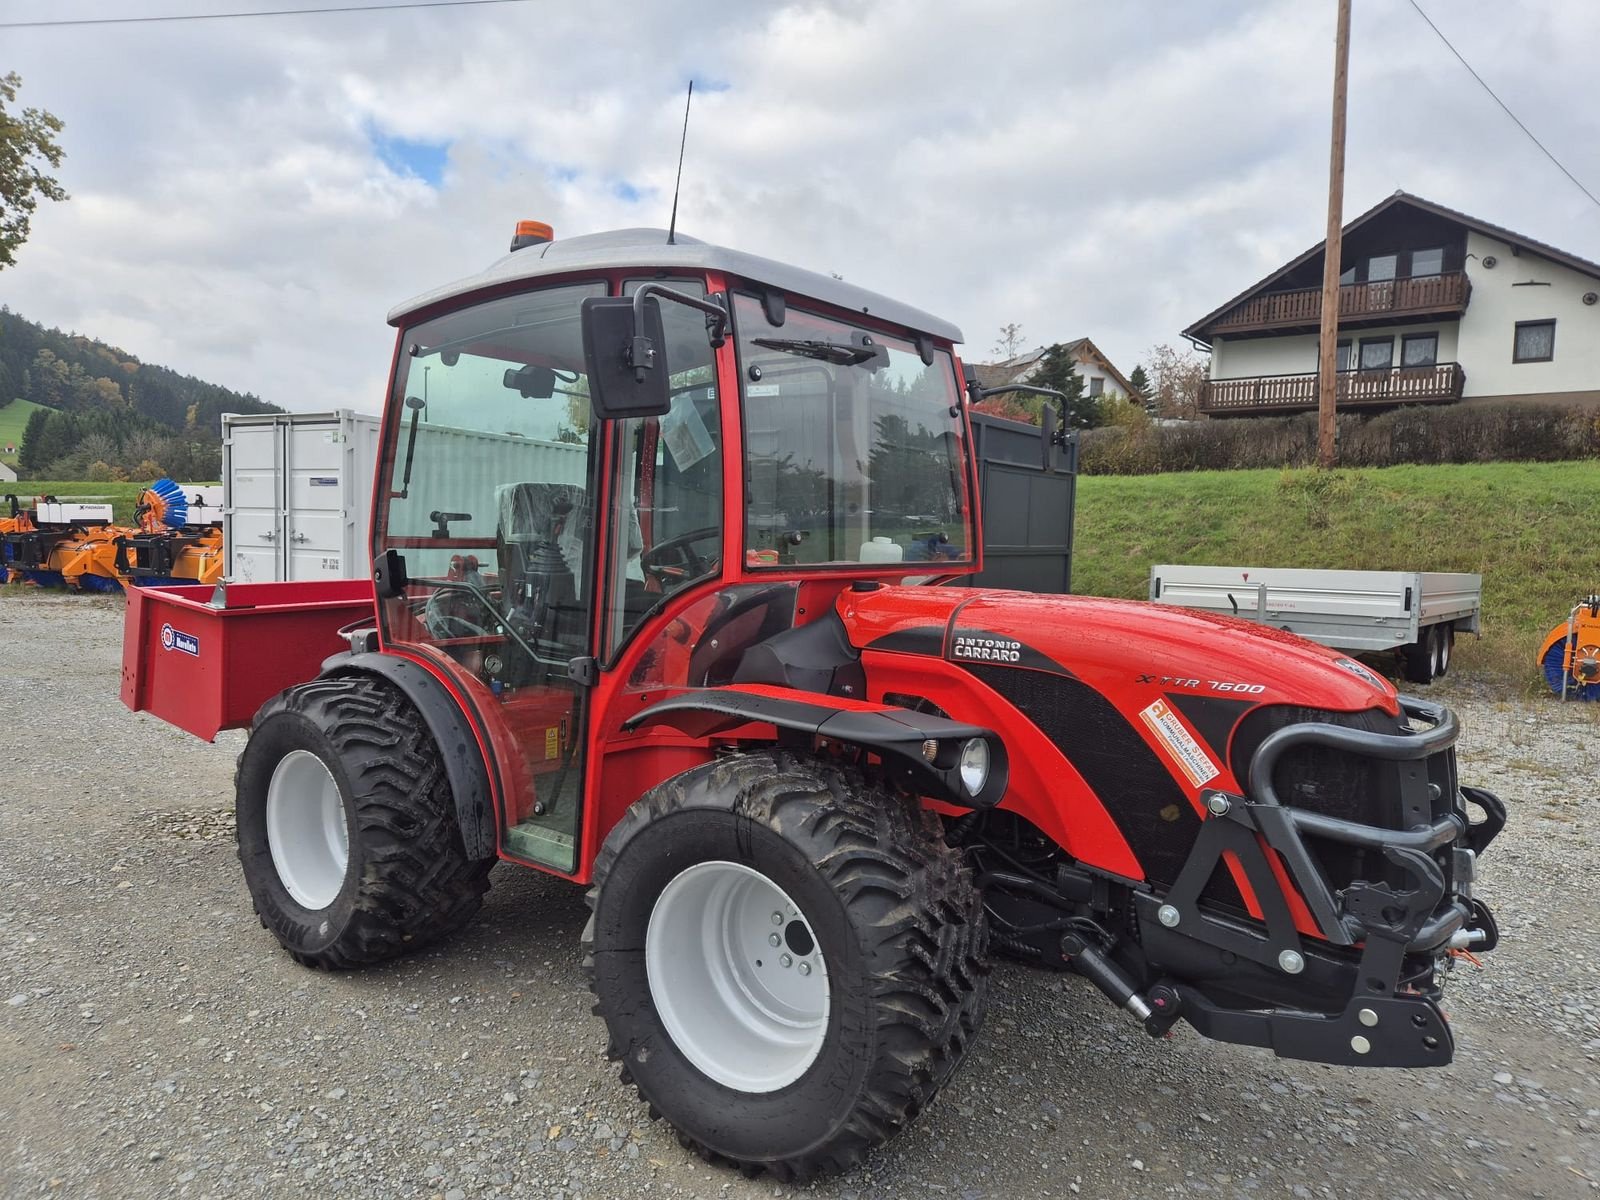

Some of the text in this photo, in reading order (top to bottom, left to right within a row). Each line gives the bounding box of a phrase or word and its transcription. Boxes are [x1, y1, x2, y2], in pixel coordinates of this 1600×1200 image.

[956, 637, 1021, 650] ANTONIO
[954, 645, 1020, 662] CARRARO
[1160, 676, 1200, 688] TTR
[1208, 680, 1266, 694] 7600
[1160, 718, 1210, 780] KOMMUNALMASCHINEN
[1165, 713, 1193, 746] GRUBER
[1191, 746, 1217, 776] STEFAN
